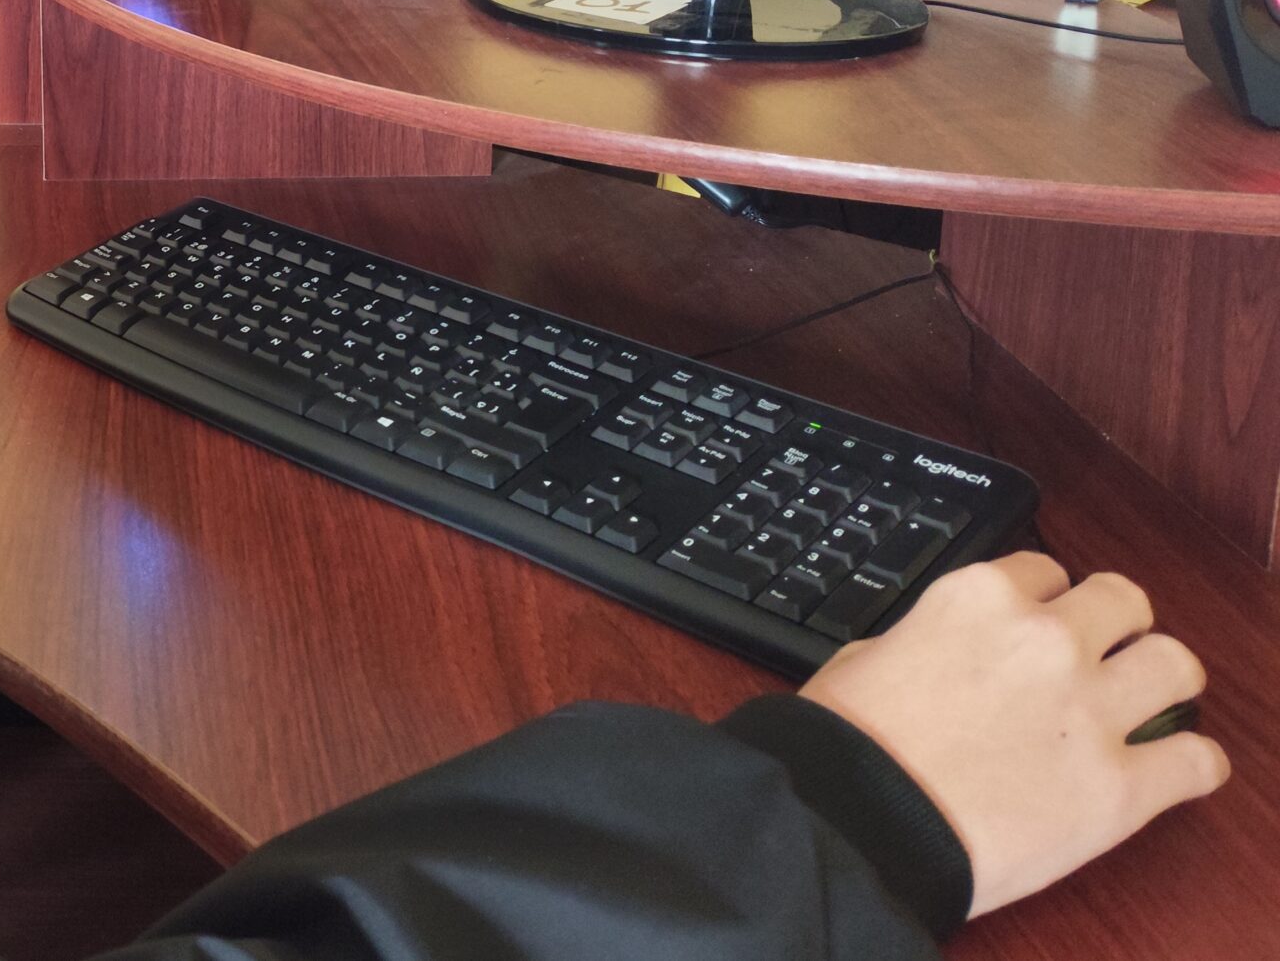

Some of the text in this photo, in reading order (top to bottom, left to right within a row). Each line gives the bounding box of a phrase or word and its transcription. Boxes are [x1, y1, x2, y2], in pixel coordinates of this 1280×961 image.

[582, 339, 599, 347] F11
[621, 351, 638, 361] F12
[548, 361, 590, 380] Retroceso
[541, 388, 568, 401] Entrar
[638, 394, 664, 407] Insert
[681, 409, 705, 422] Inicio
[616, 415, 637, 426] Supr
[471, 448, 489, 459] Ctrl
[762, 468, 774, 477] 7
[914, 454, 992, 488] logitech
[808, 487, 820, 495] 8
[736, 492, 748, 501] 4
[857, 504, 869, 513] 9
[783, 509, 796, 518] 5
[833, 528, 844, 537] 6
[757, 533, 770, 542] 2
[683, 538, 695, 547] 0
[807, 552, 819, 561] 3
[853, 573, 885, 590] Entrar
